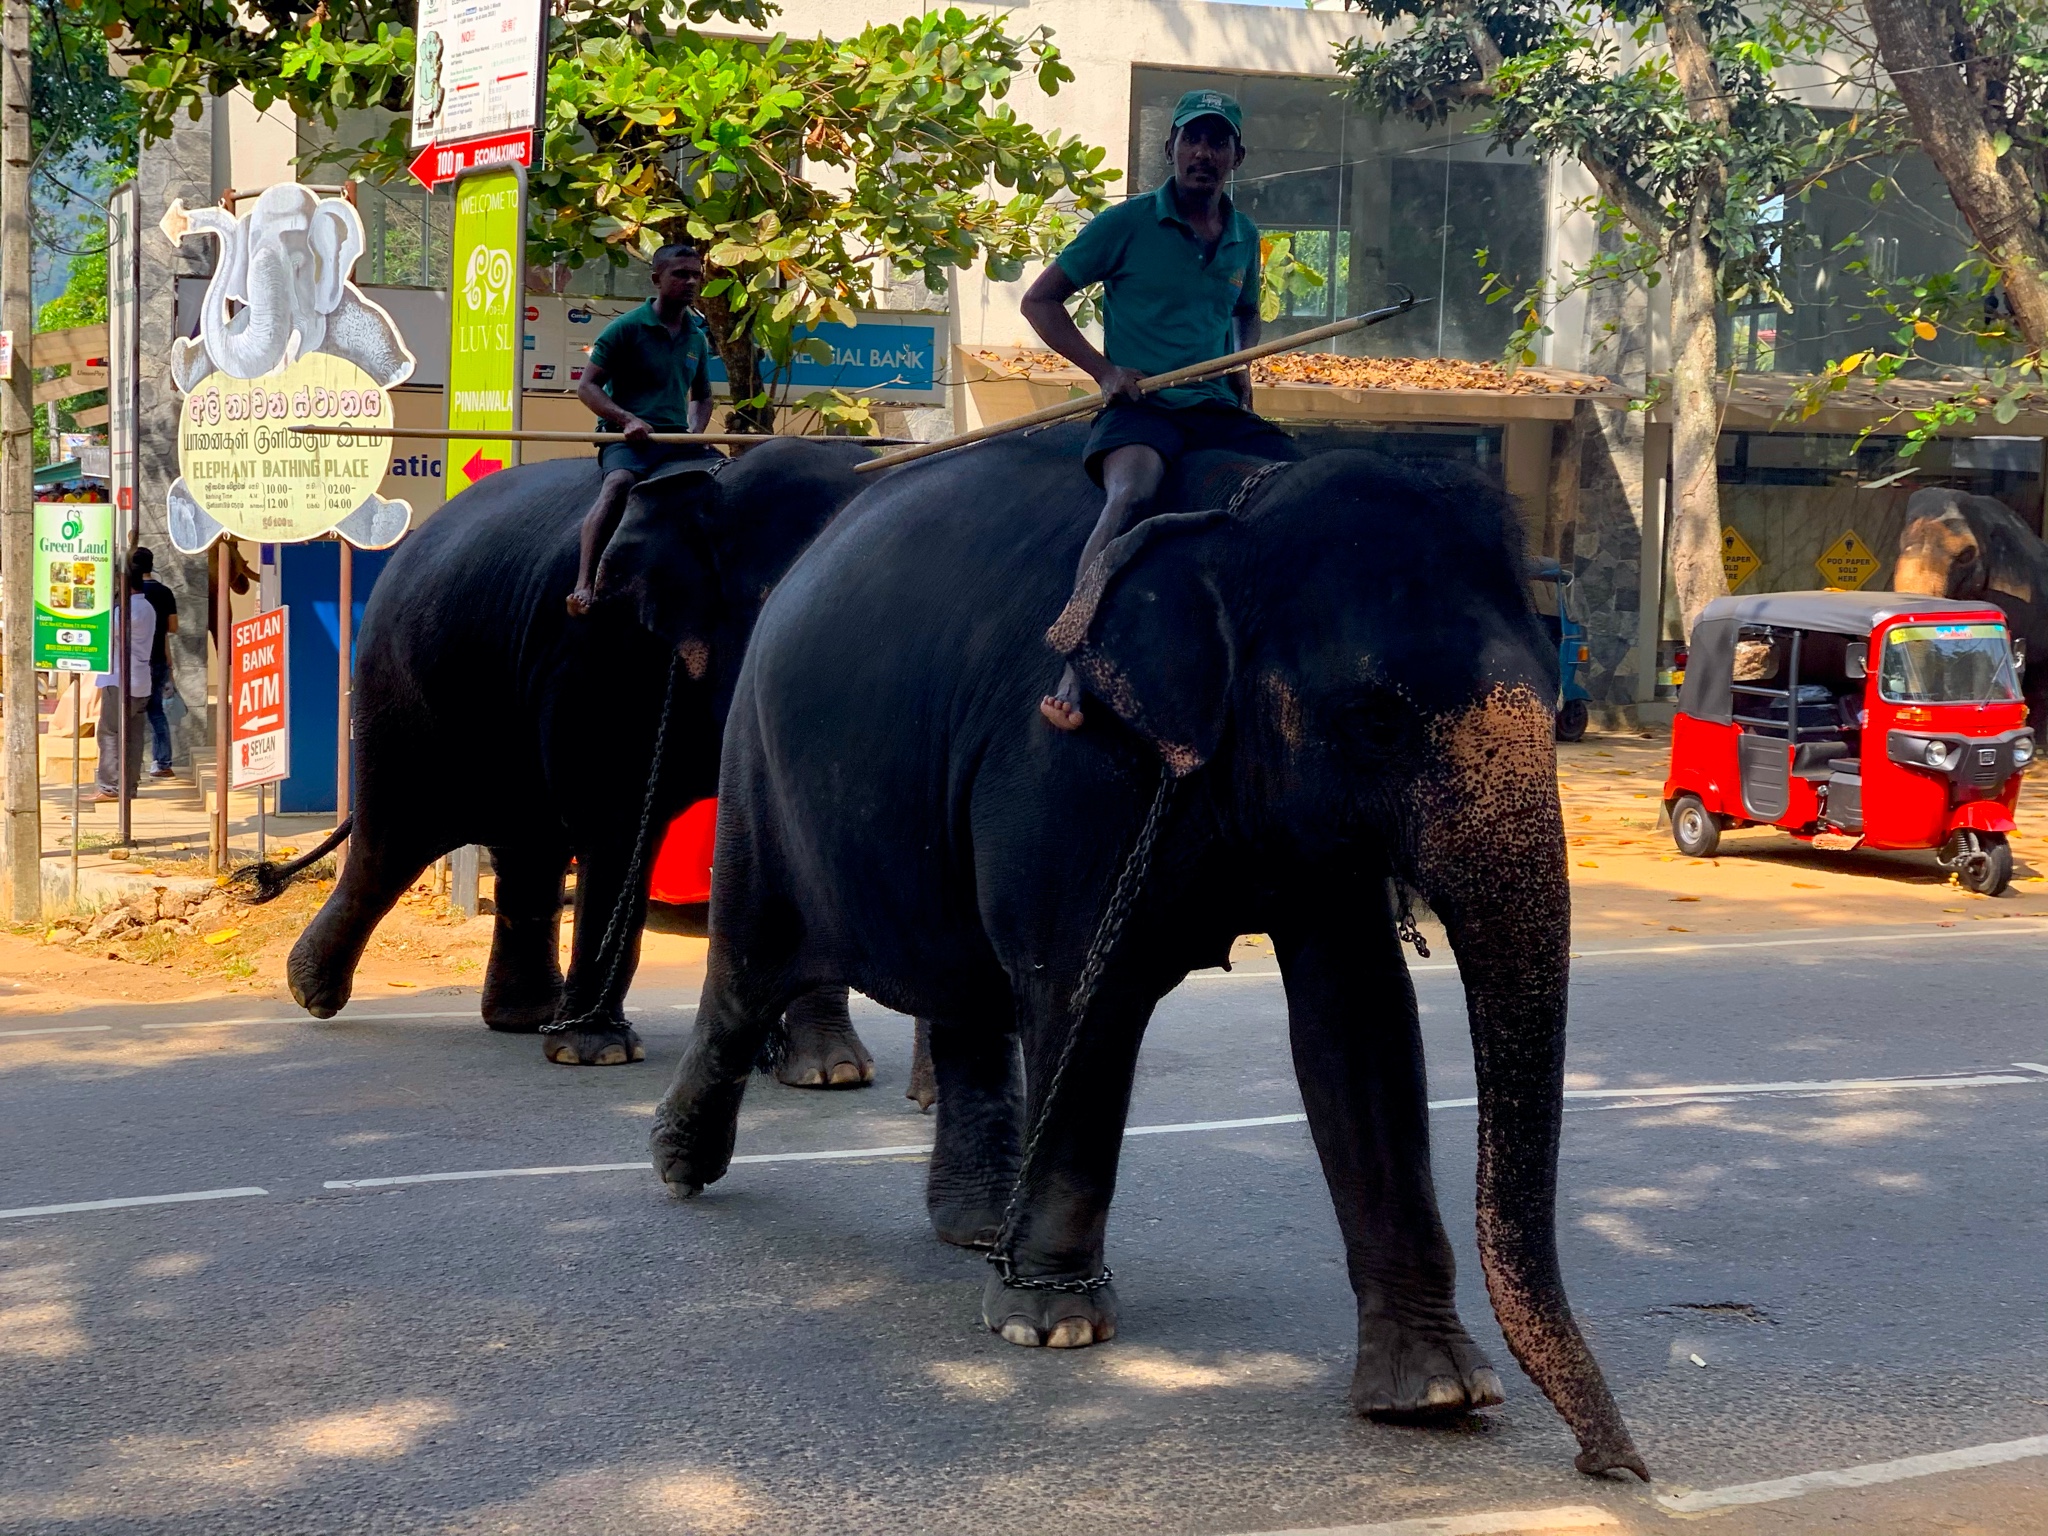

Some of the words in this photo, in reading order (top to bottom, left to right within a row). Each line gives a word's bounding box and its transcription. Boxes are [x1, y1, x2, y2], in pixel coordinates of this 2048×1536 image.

[437, 150, 455, 177] 100
[474, 141, 526, 166] ECOMAXIMUS
[461, 191, 505, 215] WELCOME
[507, 189, 518, 208] TO
[460, 325, 492, 352] LUV
[495, 323, 511, 351] SL
[869, 348, 924, 369] BANK
[189, 386, 221, 427] අලි
[225, 388, 289, 420] නාවන
[454, 390, 513, 412] PINNAWALA
[193, 459, 257, 479] ELEPHANT
[262, 459, 320, 478] BATHING
[324, 458, 369, 478] PLACE
[267, 499, 289, 509] 12.00
[328, 499, 352, 509] 04.00
[40, 537, 74, 553] Green
[78, 539, 107, 554] Land
[1846, 558, 1870, 566] PAPER
[236, 615, 281, 648] SEYLAN
[242, 644, 275, 673] BANK
[238, 673, 280, 715] ATM
[250, 736, 276, 757] SEYLAN
